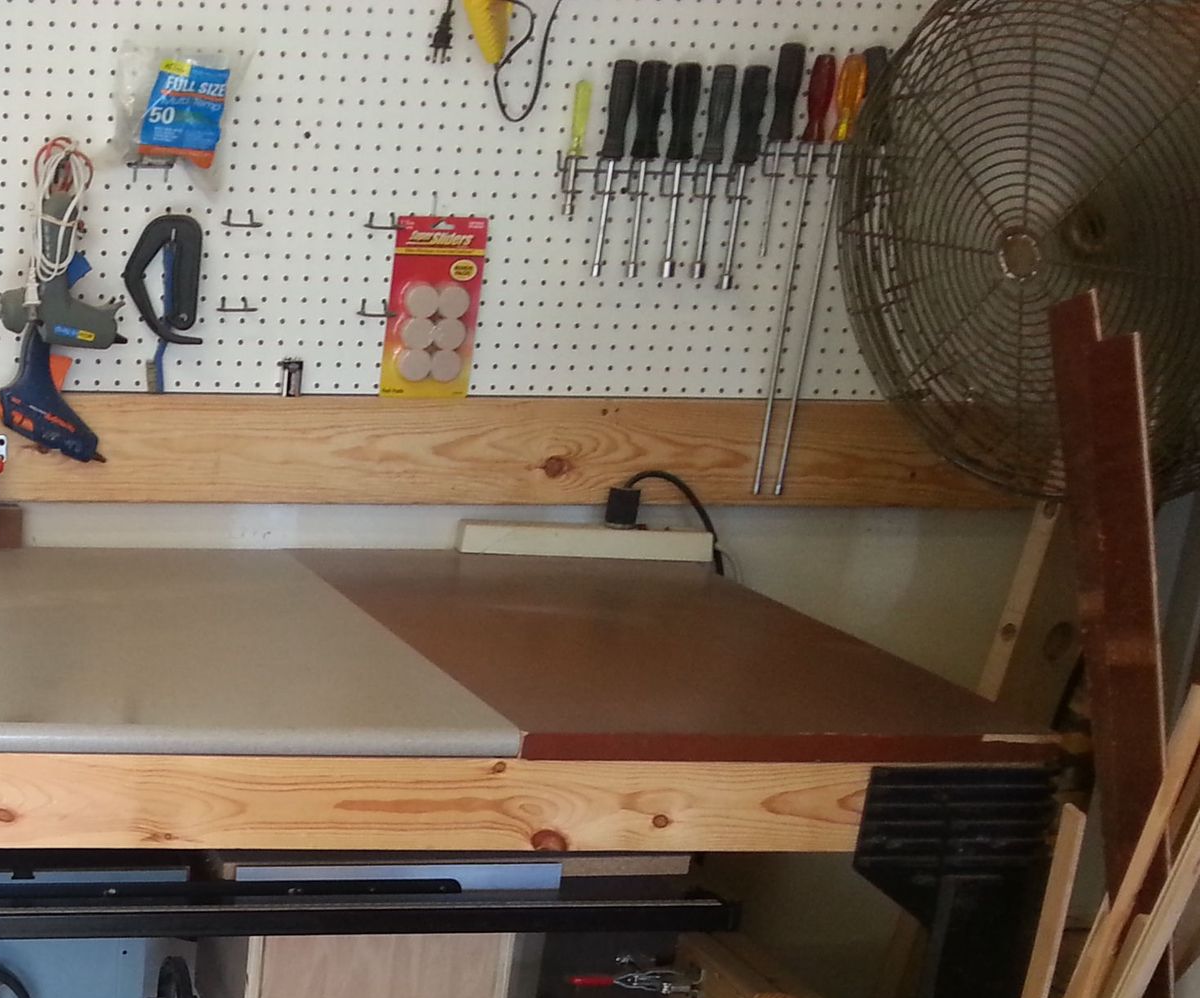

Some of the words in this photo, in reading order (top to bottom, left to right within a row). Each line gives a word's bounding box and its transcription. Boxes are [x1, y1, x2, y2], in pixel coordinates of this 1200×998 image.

[166, 76, 196, 92] FULL
[198, 82, 226, 97] SIZE
[148, 106, 176, 125] 50
